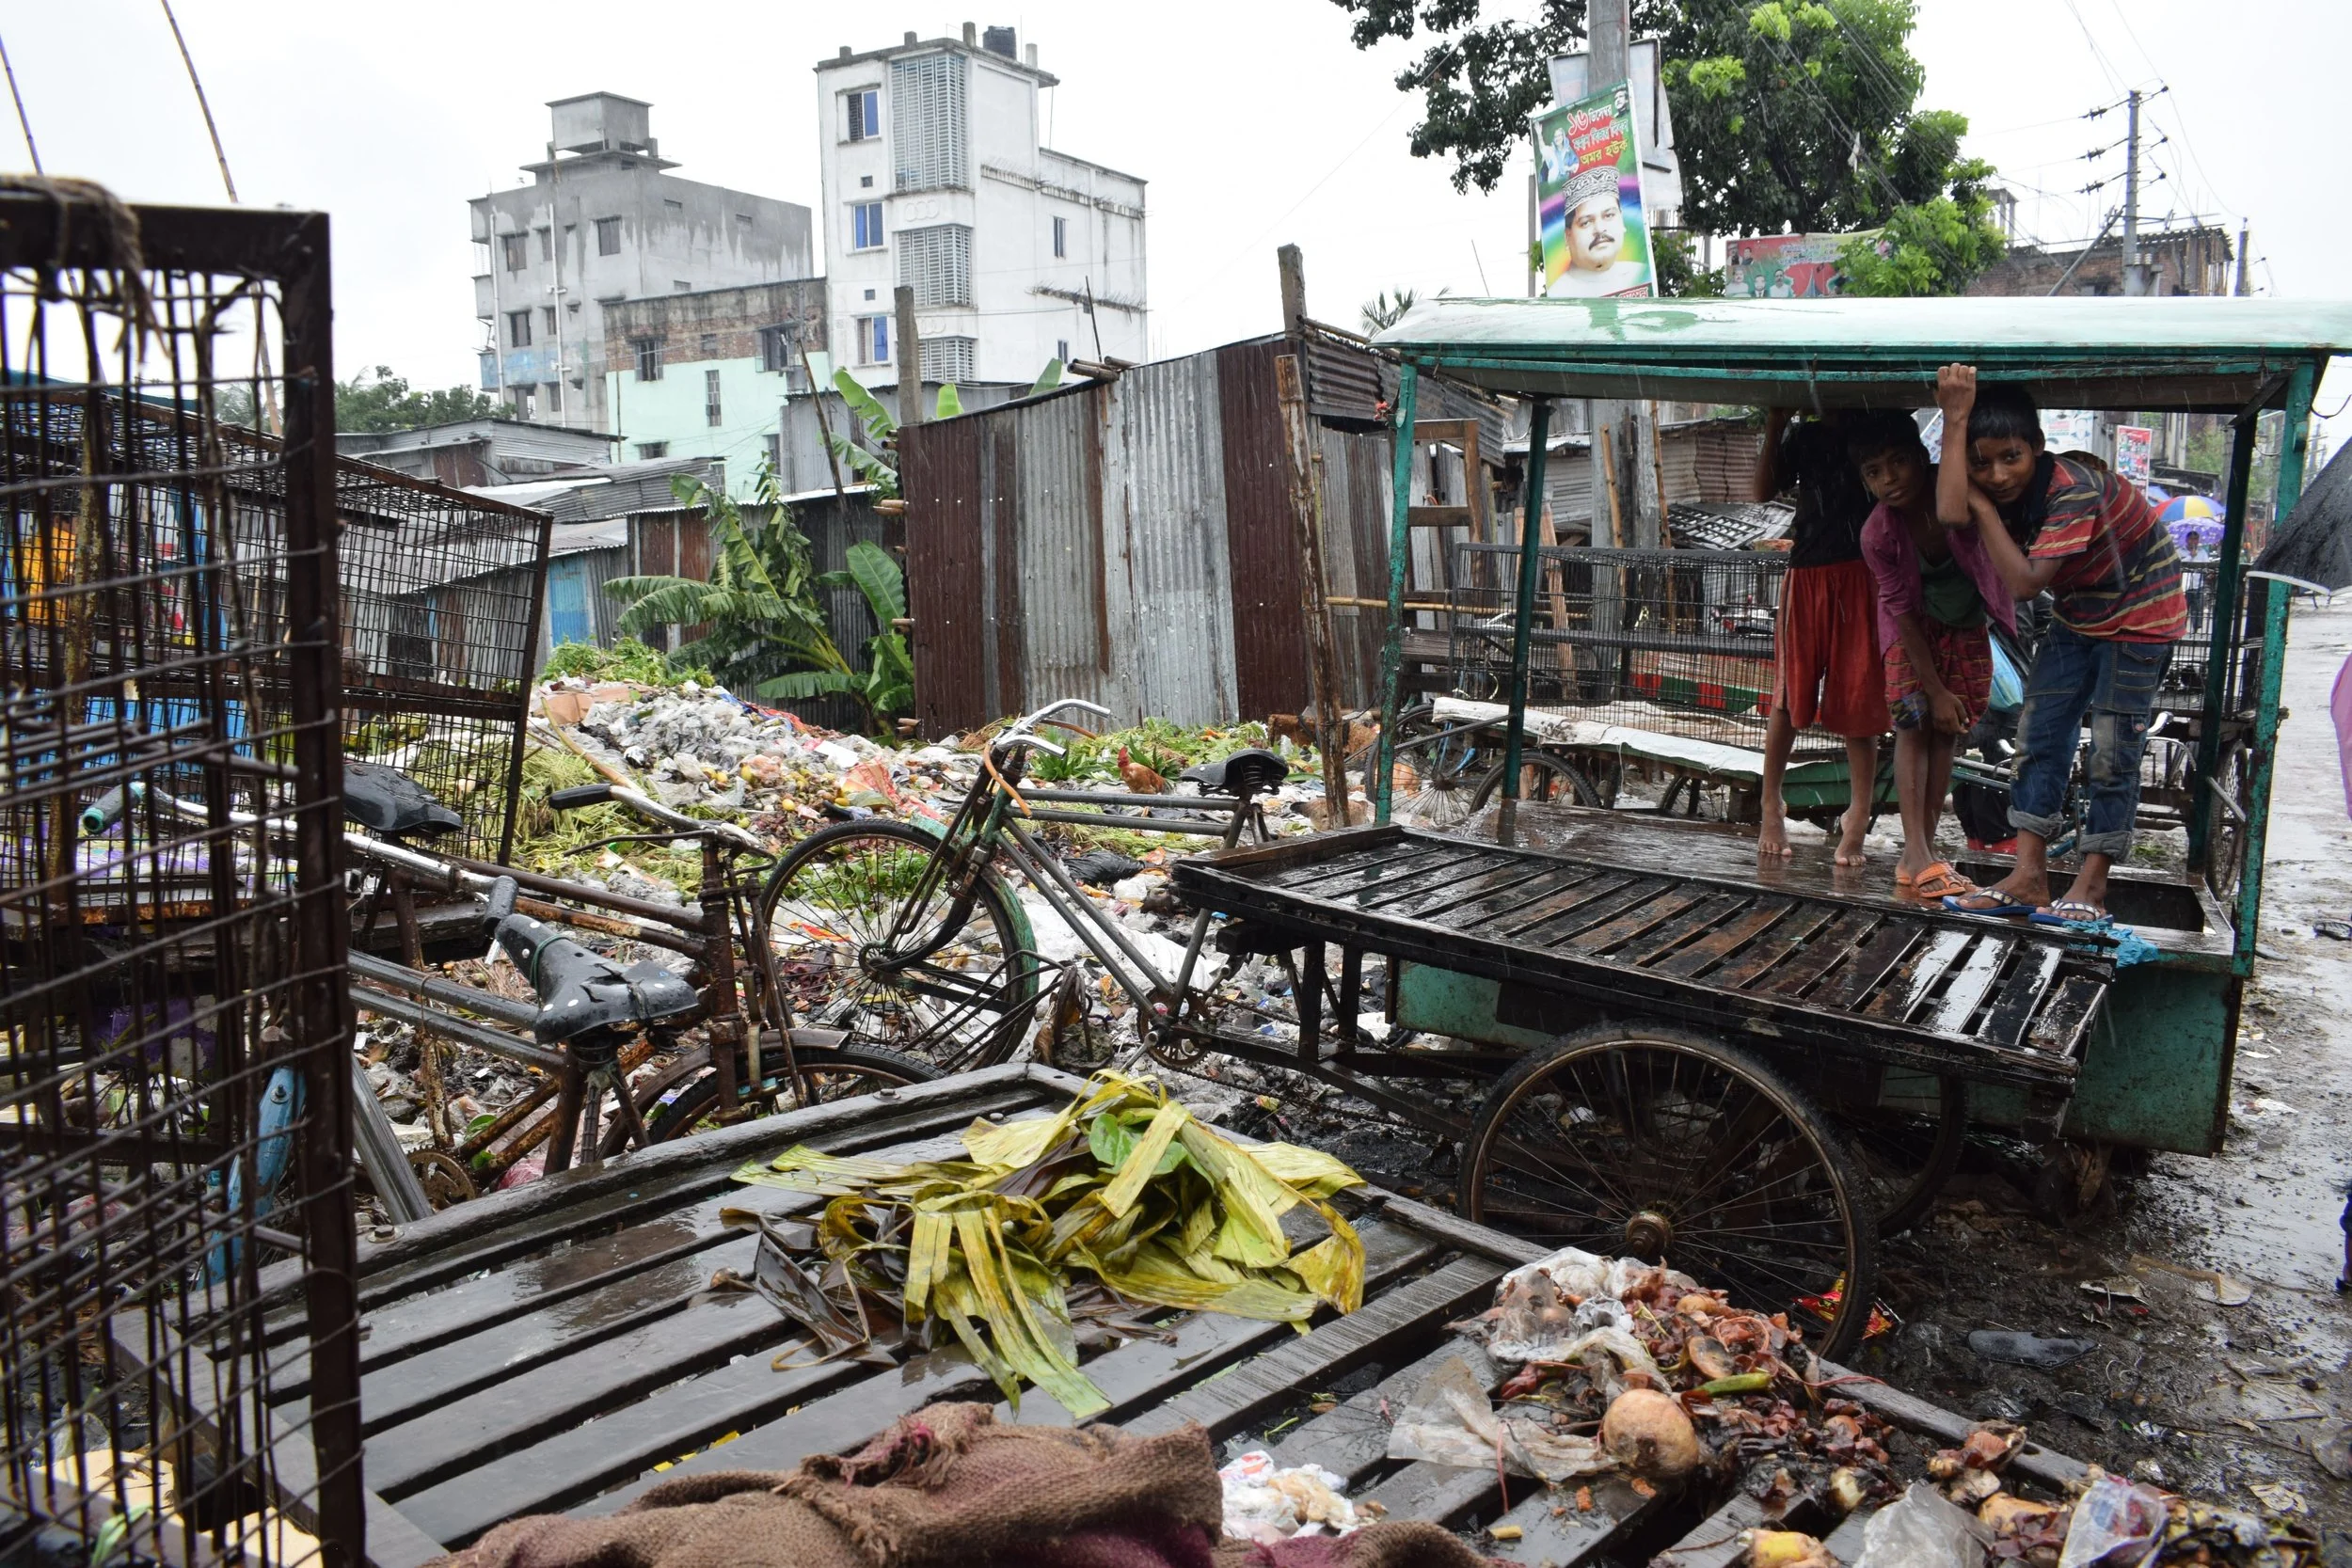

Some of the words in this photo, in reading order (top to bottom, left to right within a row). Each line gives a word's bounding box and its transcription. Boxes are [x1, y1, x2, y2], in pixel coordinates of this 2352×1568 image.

[1567, 109, 1588, 135] ১৬
[1580, 150, 1603, 165] অমর
[1604, 139, 1628, 157] হউক
